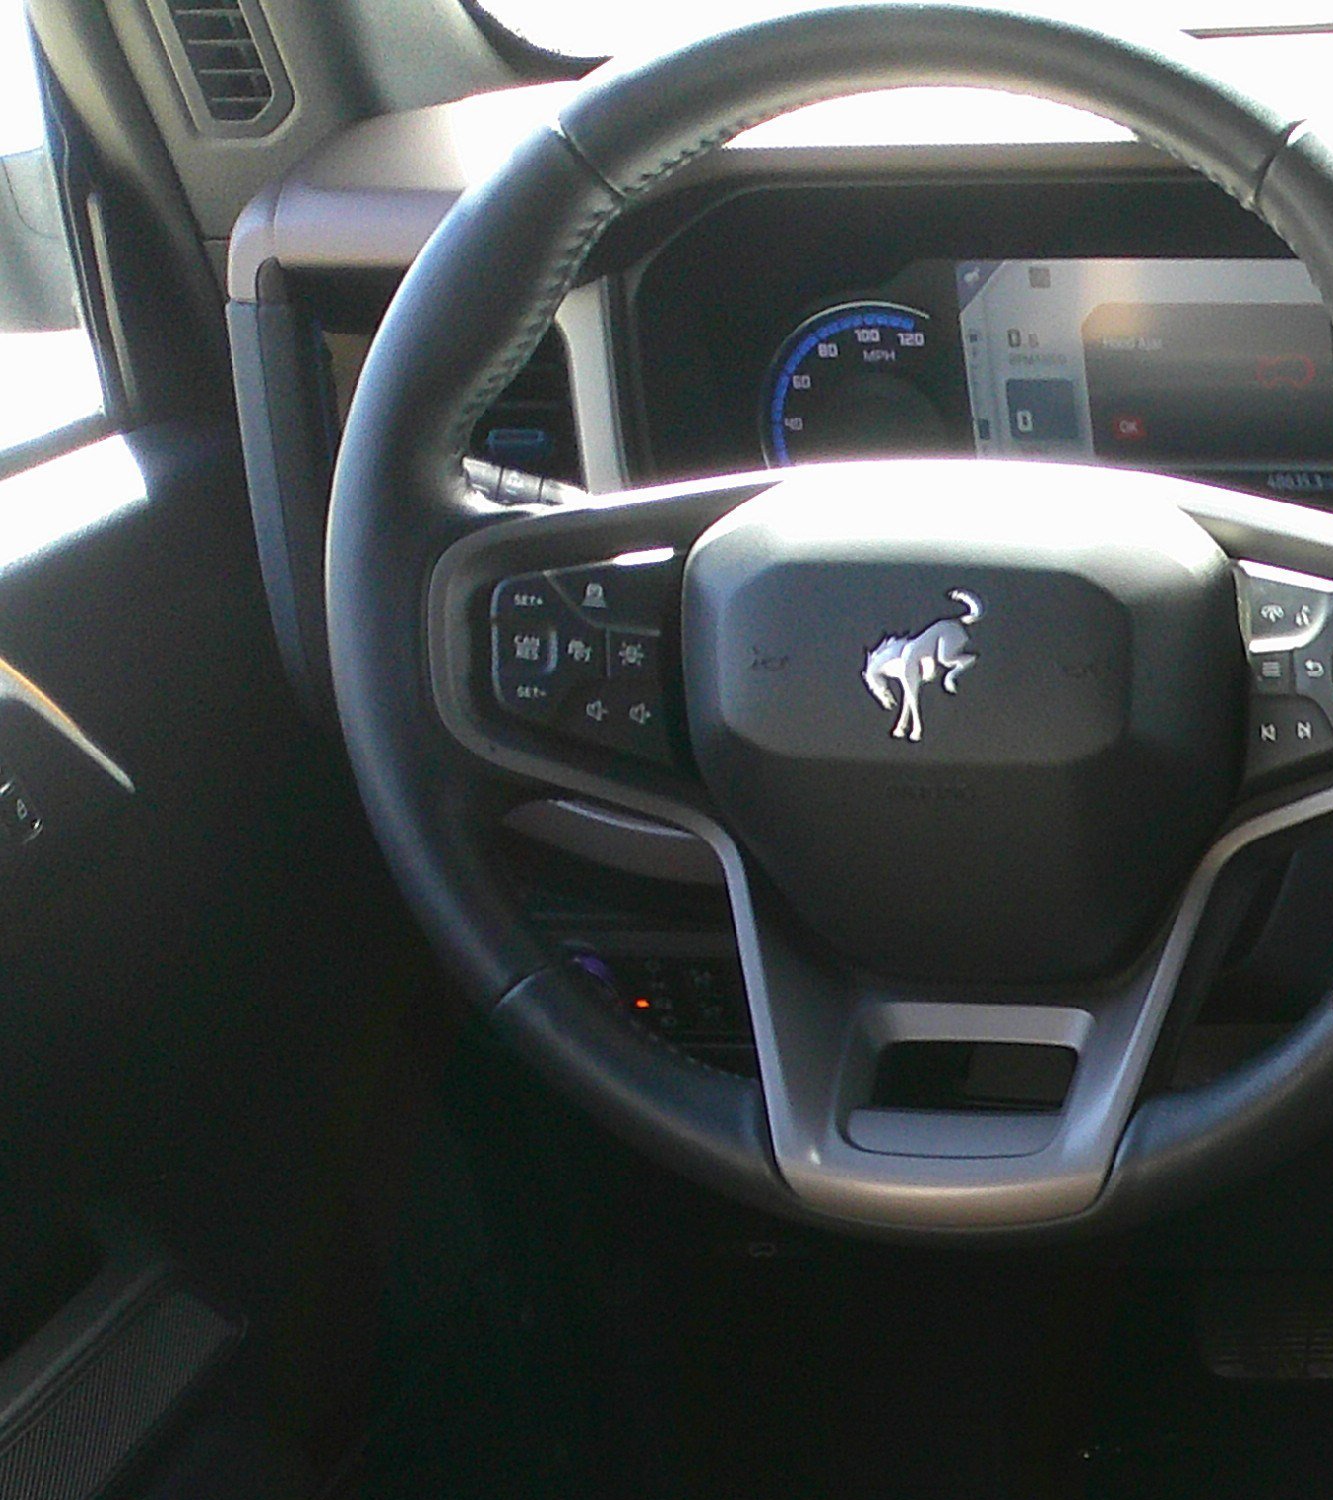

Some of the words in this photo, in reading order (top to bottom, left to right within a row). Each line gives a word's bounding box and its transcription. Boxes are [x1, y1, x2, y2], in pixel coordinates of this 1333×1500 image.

[854, 328, 880, 343] 100
[897, 332, 925, 347] 120
[817, 343, 838, 358] 80
[862, 349, 896, 362] MPH
[792, 375, 811, 389] 60
